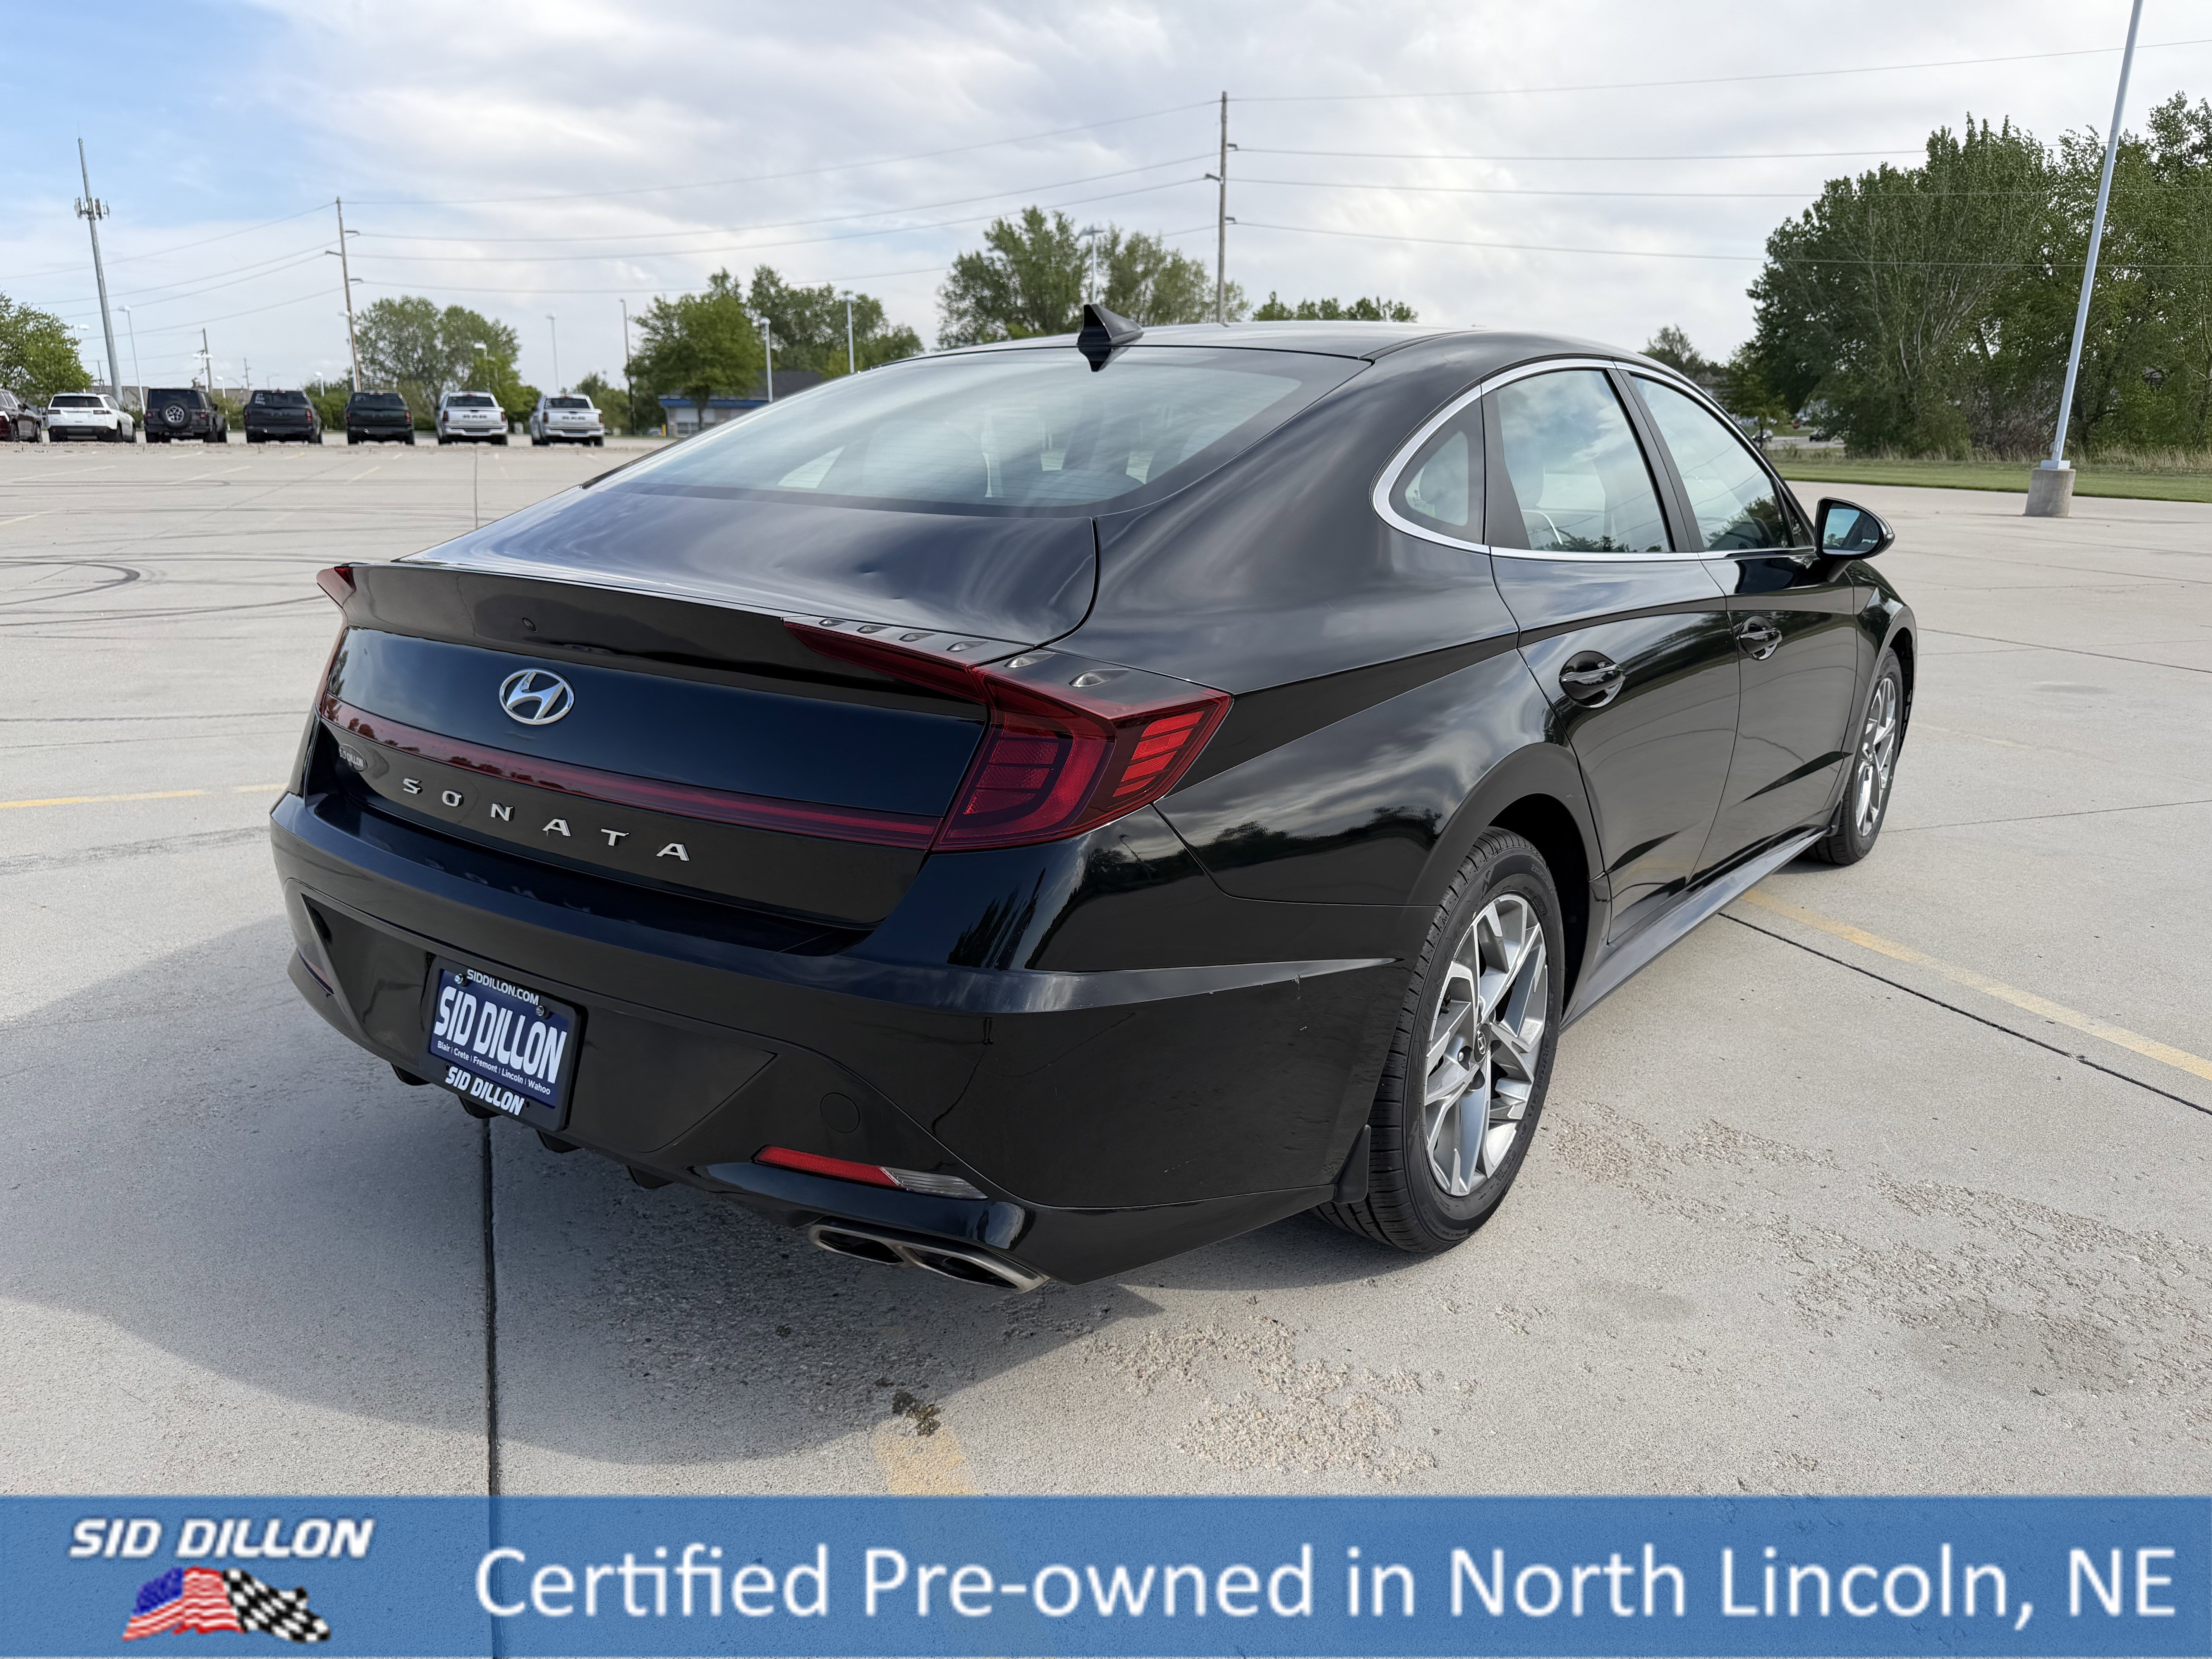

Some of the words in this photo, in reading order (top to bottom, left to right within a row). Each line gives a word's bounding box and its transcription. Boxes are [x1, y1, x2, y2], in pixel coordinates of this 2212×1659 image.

[402, 776, 690, 862] SONATA
[467, 969, 539, 1006] SIDDILLON.COM
[434, 986, 477, 1046] SID
[473, 1001, 567, 1084] DILLON
[438, 1040, 450, 1052] Blair
[454, 1048, 469, 1061] Crete
[473, 1056, 498, 1073] Fremont
[501, 1068, 523, 1084] Lincoln
[528, 1079, 551, 1095] Wahoo
[445, 1066, 471, 1091] SID
[470, 1077, 525, 1116] DILLON
